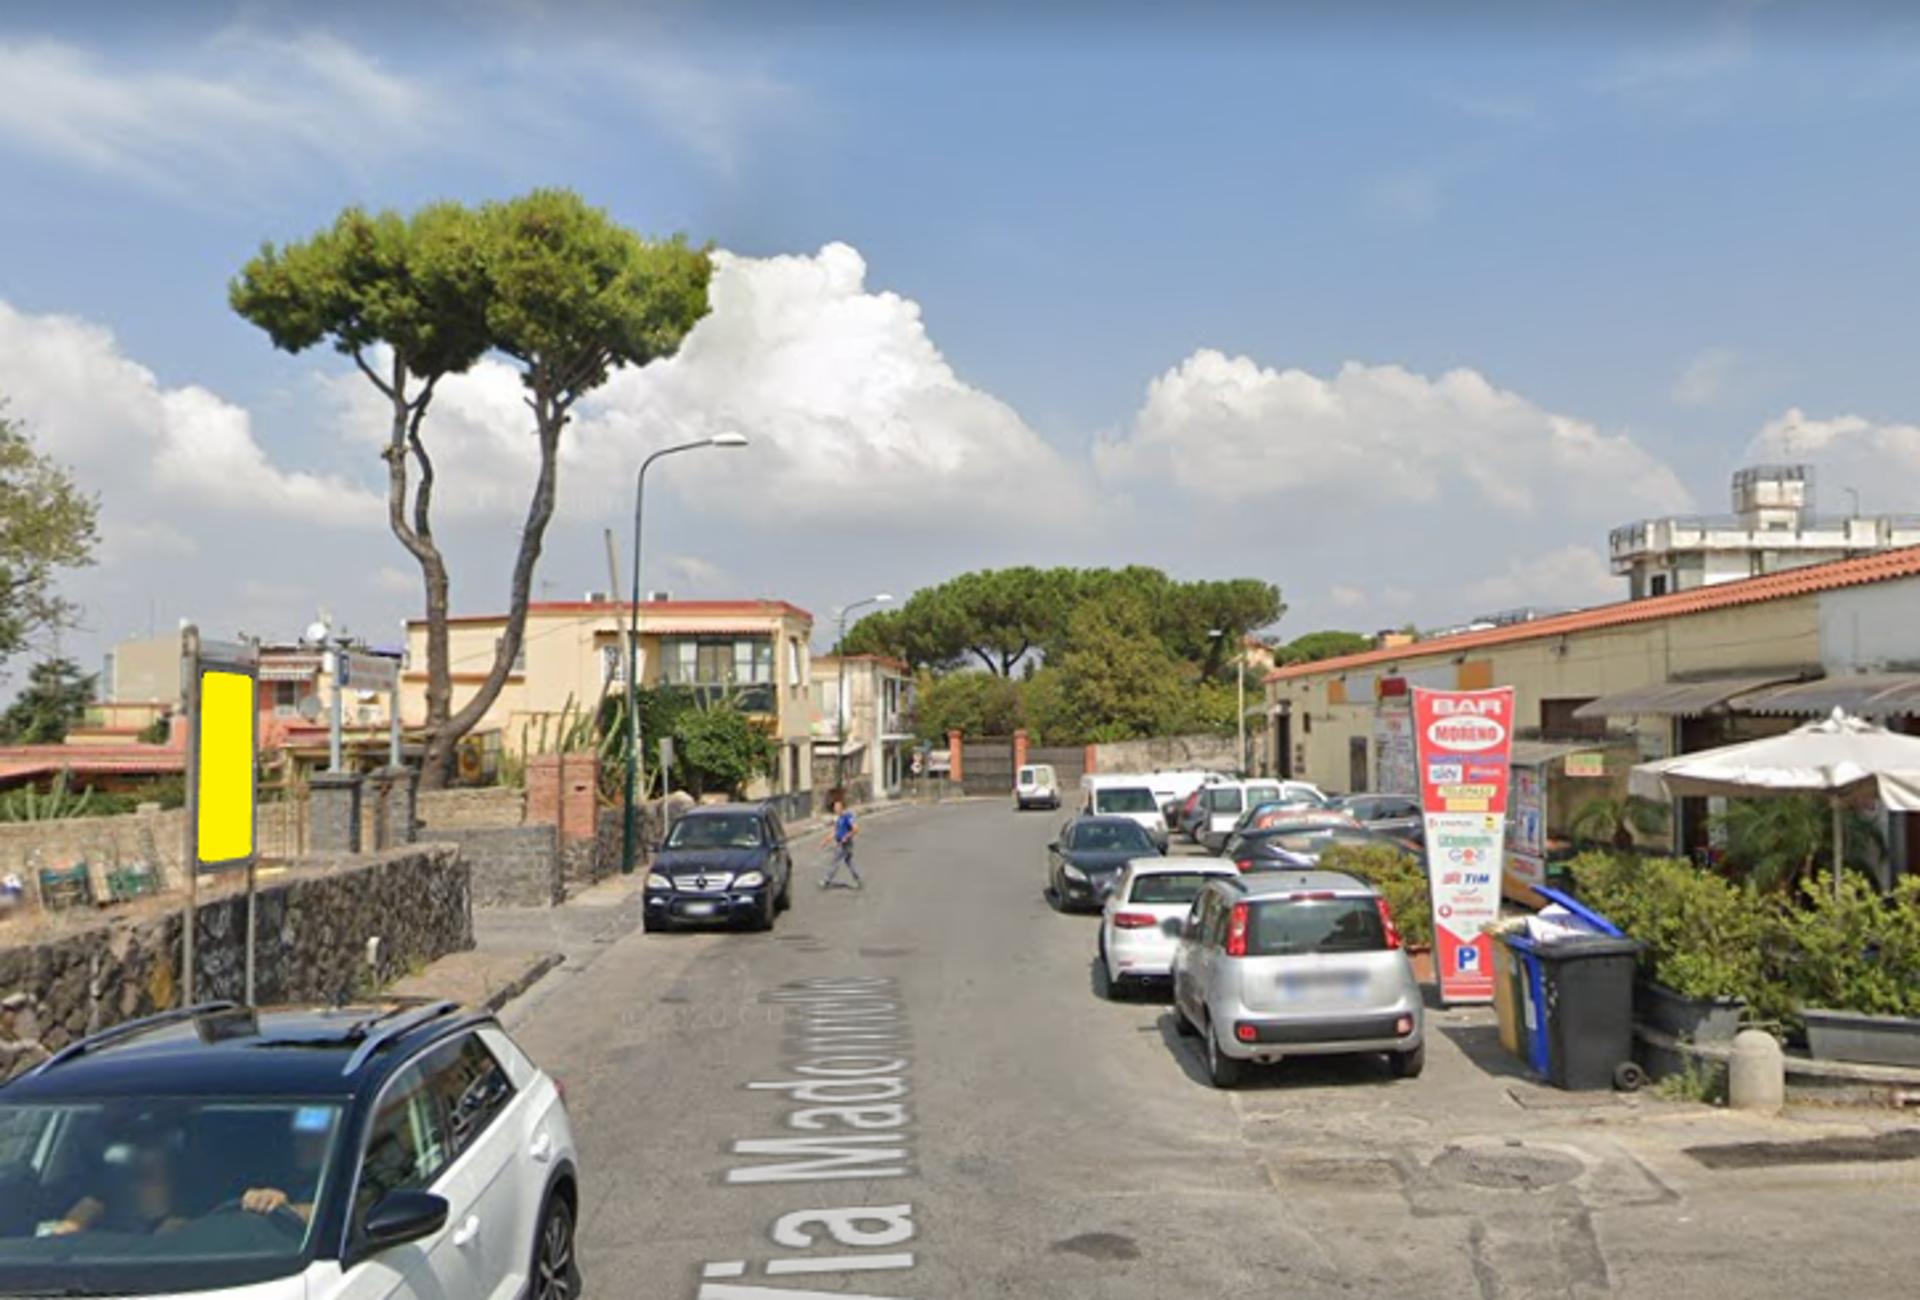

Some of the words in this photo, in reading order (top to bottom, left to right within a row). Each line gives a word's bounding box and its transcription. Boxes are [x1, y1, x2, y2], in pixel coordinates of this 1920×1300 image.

[1432, 699, 1501, 715] BAR
[1434, 725, 1498, 742] MORENO
[1464, 872, 1489, 884] TIM
[1458, 947, 1476, 970] P
